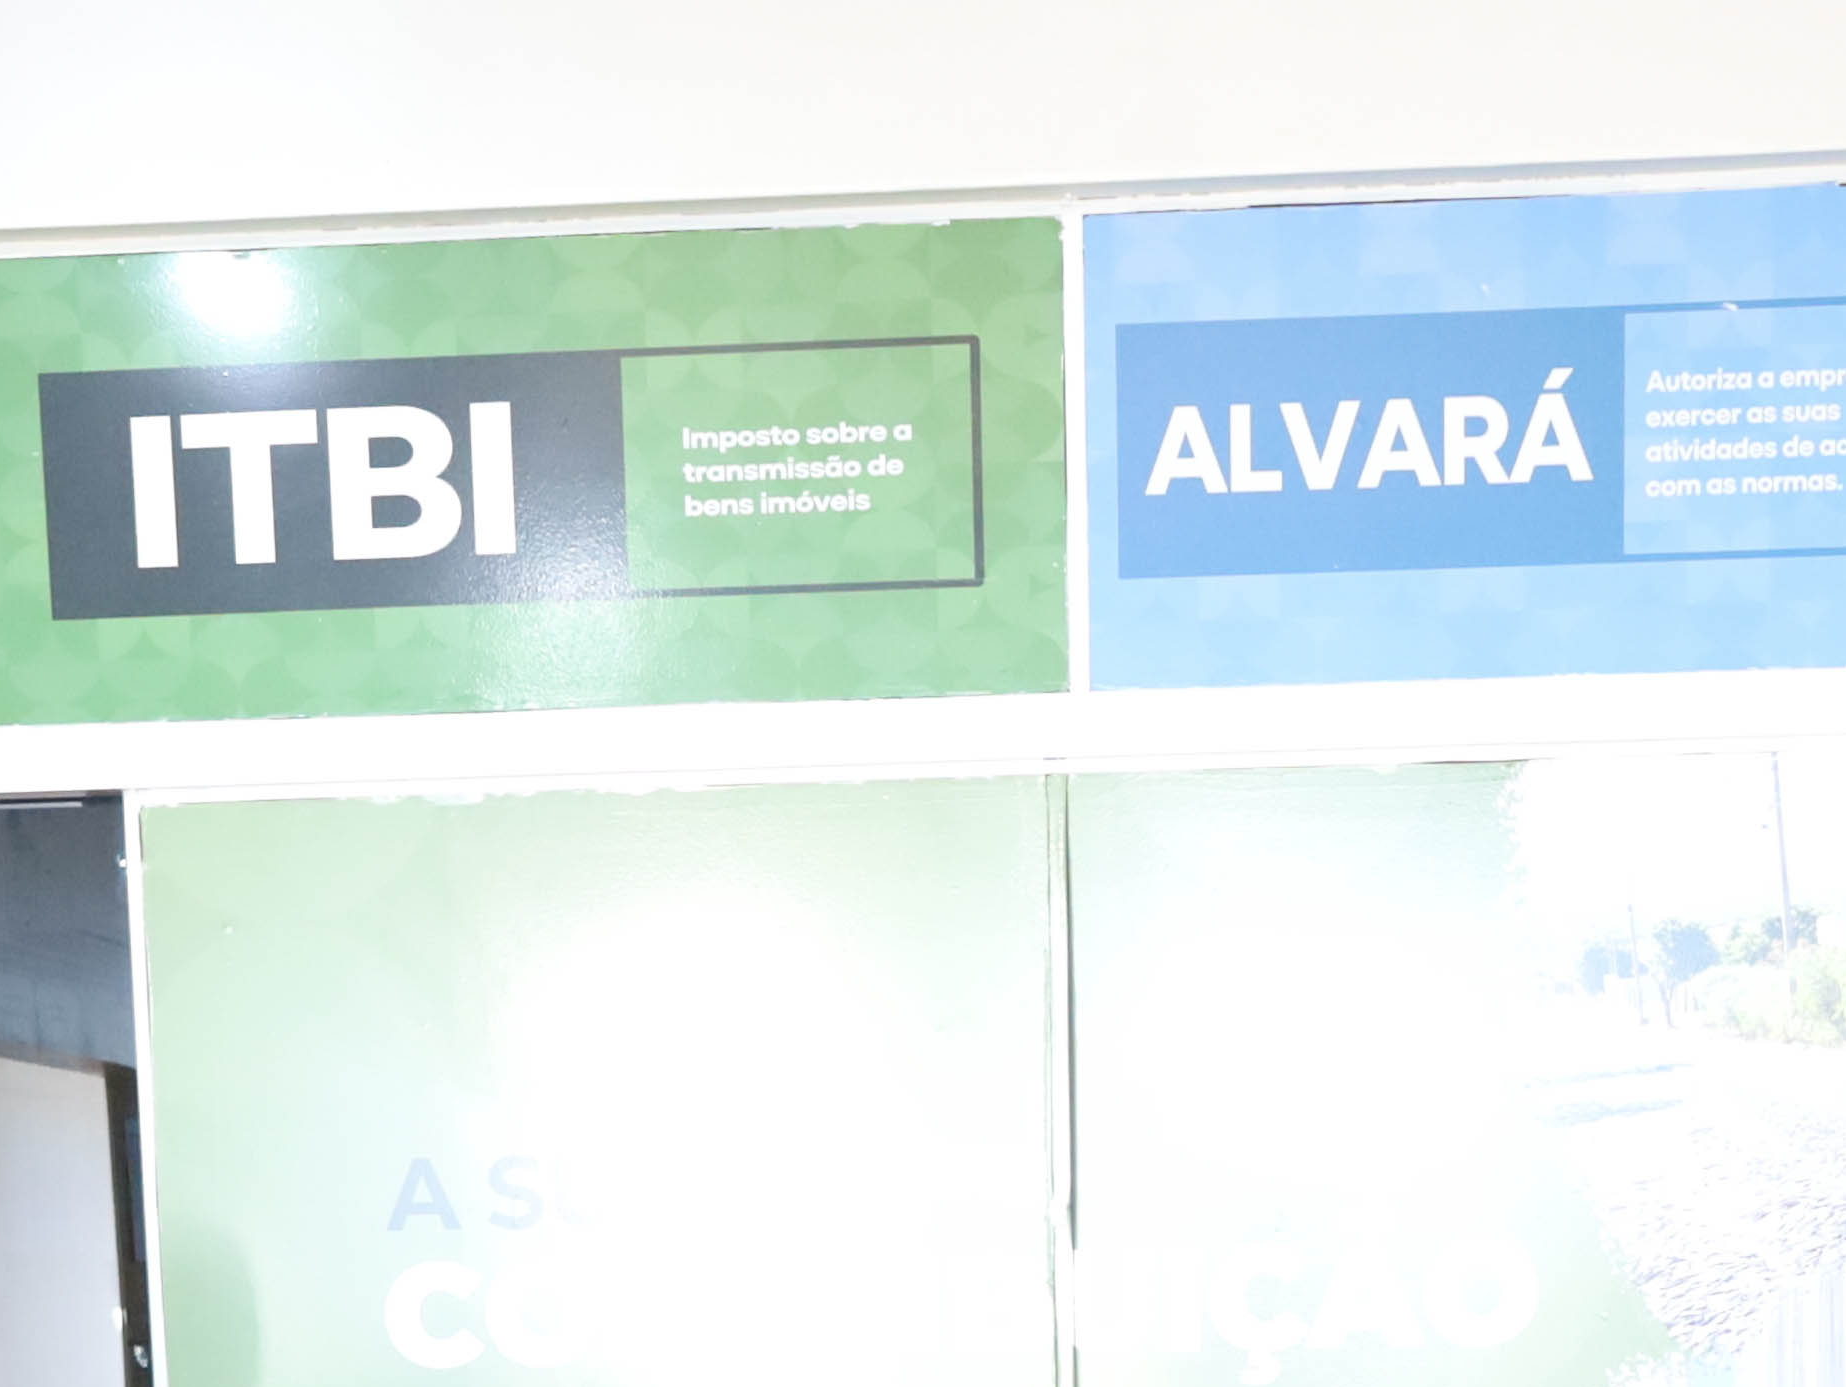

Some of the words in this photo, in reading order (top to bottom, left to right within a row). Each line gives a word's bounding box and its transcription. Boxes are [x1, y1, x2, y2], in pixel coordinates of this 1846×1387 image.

[1646, 368, 1753, 393] Autoriza
[1757, 371, 1775, 389] a
[1645, 406, 1742, 428] exercer
[1746, 405, 1777, 424] as
[1782, 402, 1841, 422] suas
[682, 426, 801, 453] Imposto
[806, 421, 888, 445] sobre
[893, 423, 913, 441] a
[1145, 366, 1594, 496] ALVARÁ
[1645, 437, 1778, 463] atividades
[1782, 434, 1815, 457] de
[682, 455, 863, 483] transmissão
[867, 453, 905, 477] de
[128, 400, 518, 569] ITBI
[1645, 476, 1701, 497] com
[1706, 475, 1736, 496] as
[1742, 472, 1844, 494] normas.
[684, 495, 755, 517] bens
[760, 488, 872, 514] imóveis
